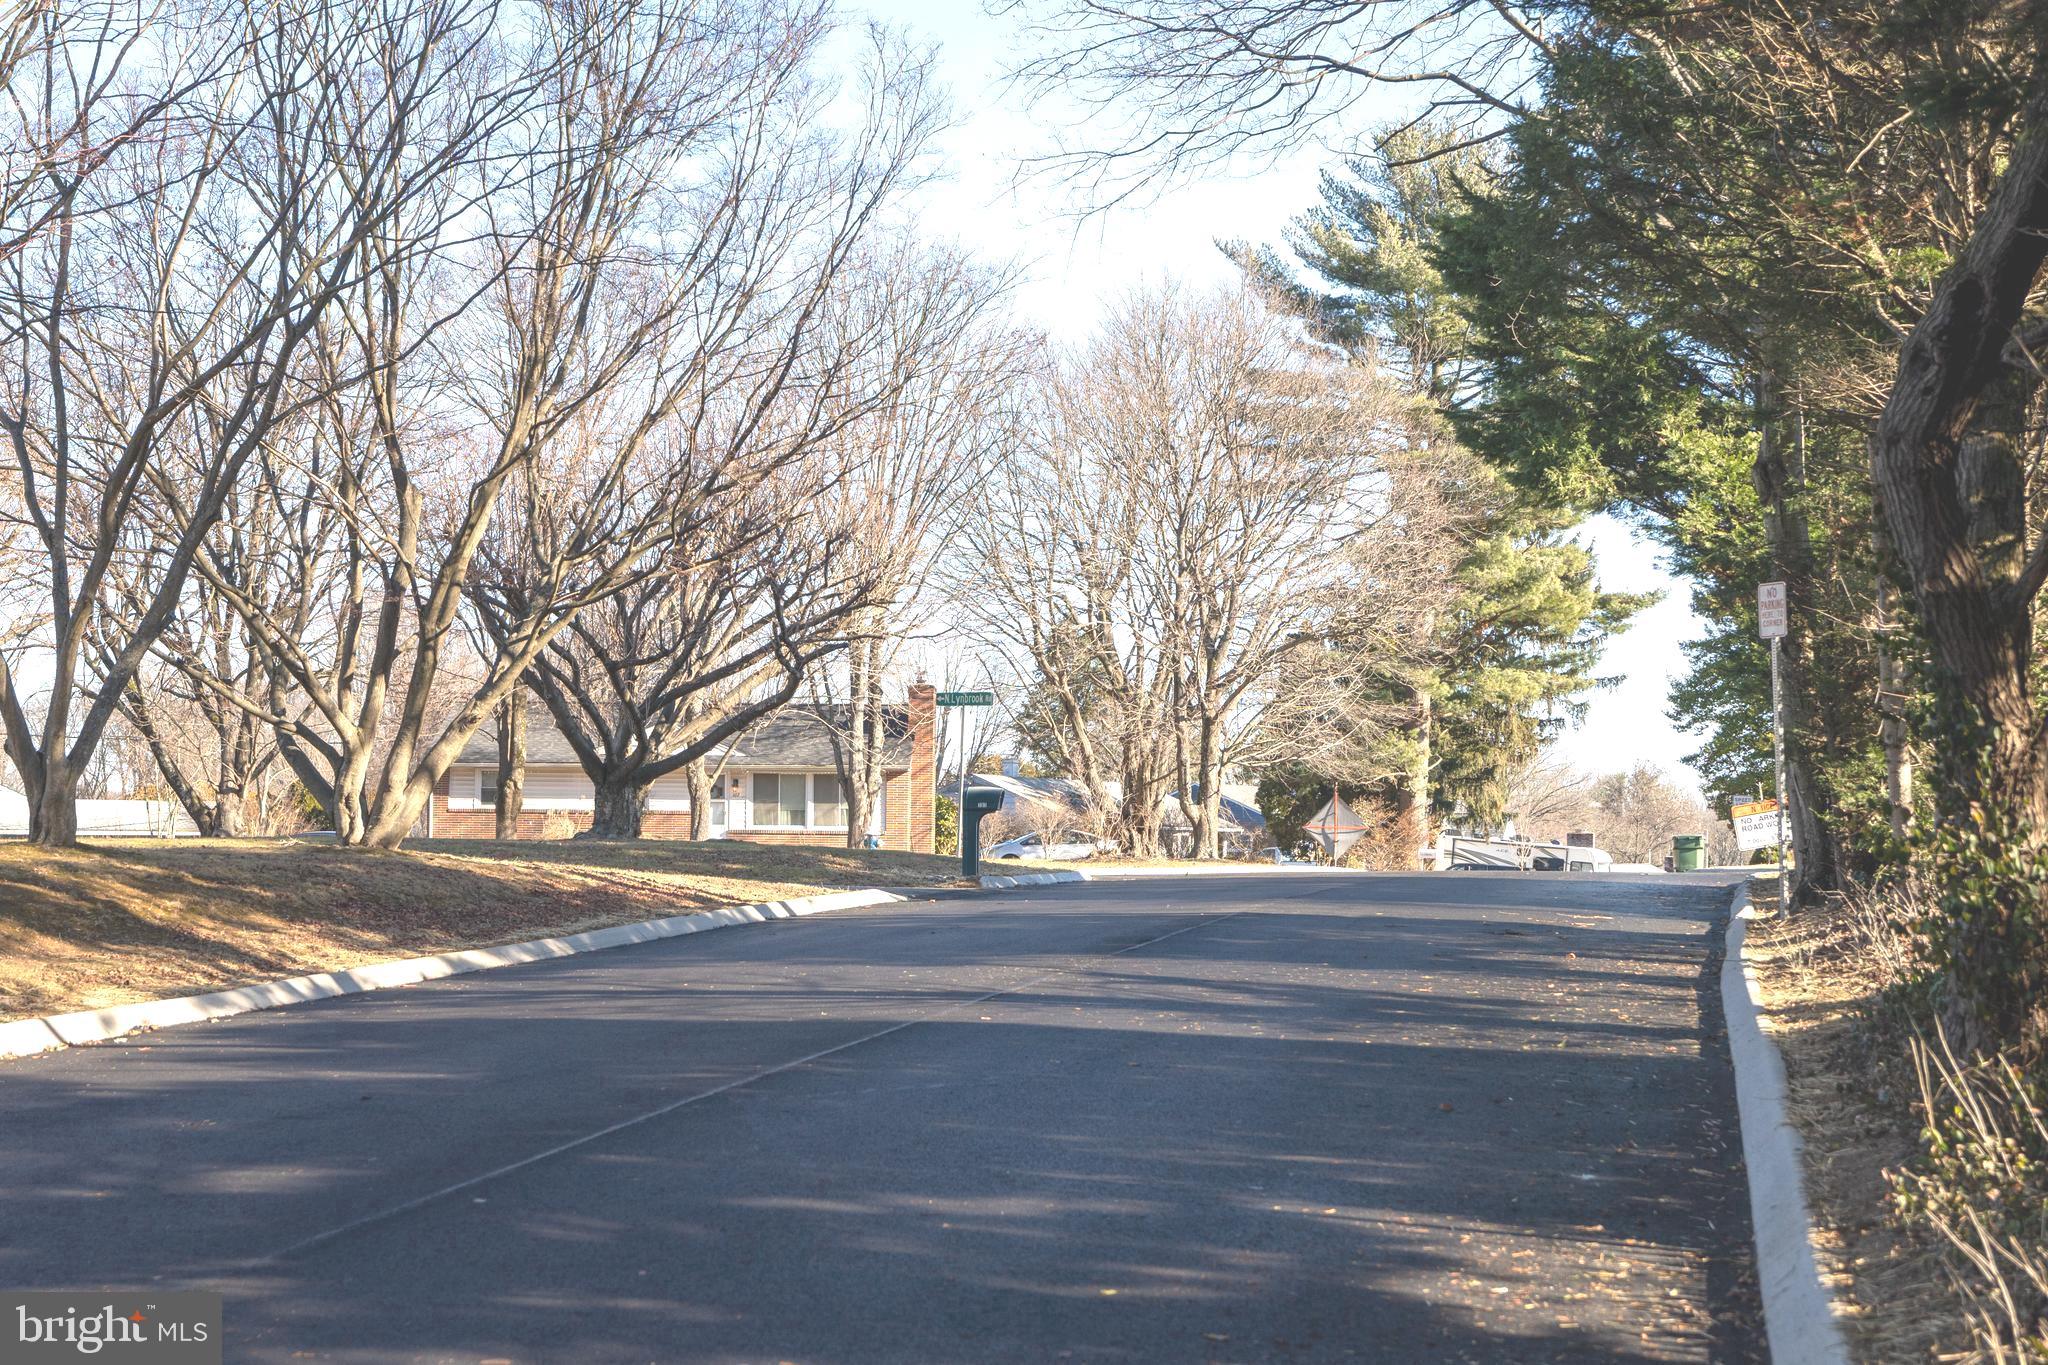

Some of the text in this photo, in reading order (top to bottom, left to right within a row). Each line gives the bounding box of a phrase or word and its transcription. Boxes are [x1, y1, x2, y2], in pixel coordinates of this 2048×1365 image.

[1766, 587, 1777, 598] NO
[1760, 600, 1784, 609] PARKING
[1762, 619, 1783, 627] CORNER
[944, 694, 950, 704] N
[951, 693, 984, 706] Lynbrook
[1741, 817, 1753, 825] NO
[1741, 823, 1764, 832] ROAD
